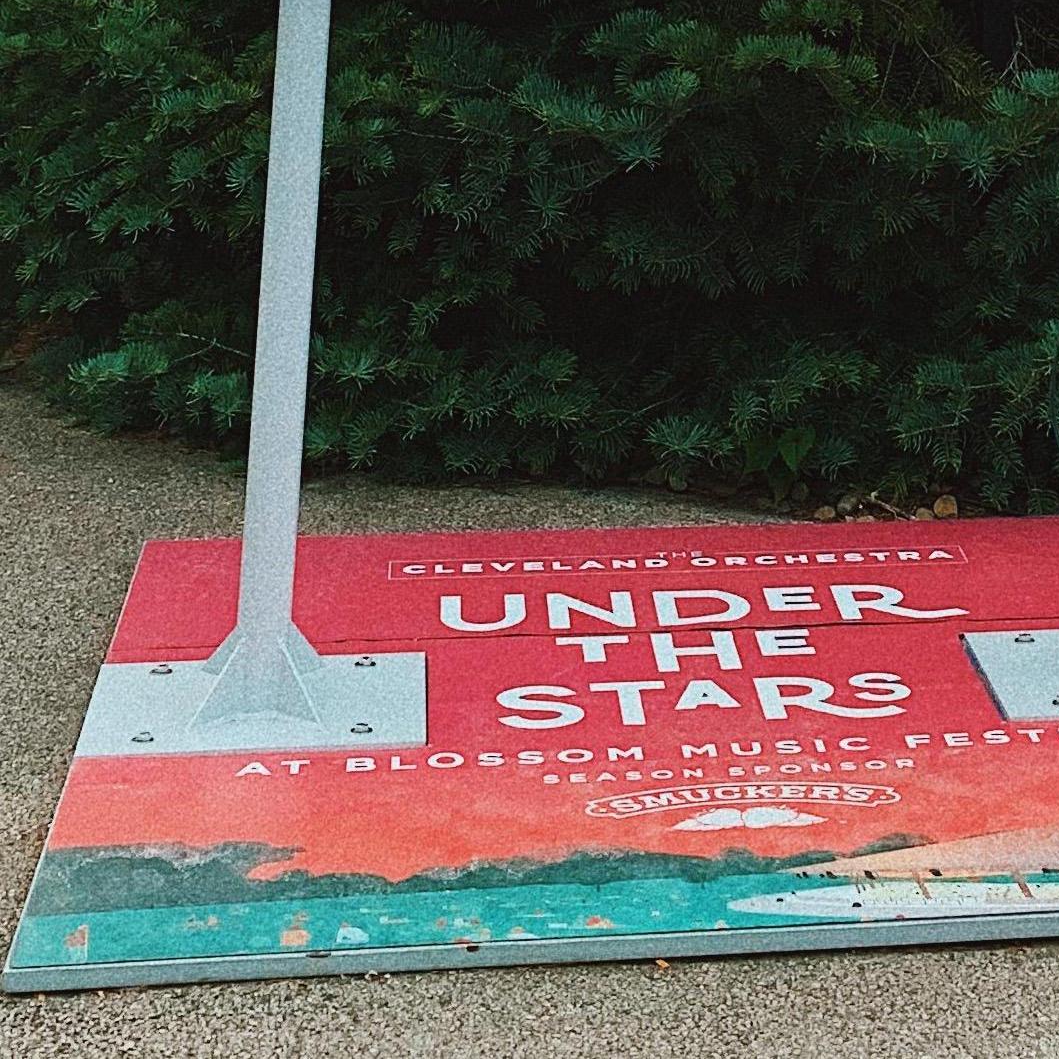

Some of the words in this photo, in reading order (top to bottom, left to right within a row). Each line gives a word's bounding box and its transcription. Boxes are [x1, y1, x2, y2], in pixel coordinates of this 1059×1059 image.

[402, 557, 670, 575] CLEVELAND
[691, 548, 954, 568] ORCHESTRA
[655, 550, 704, 559] THE
[439, 583, 970, 632] UNDER
[555, 628, 817, 673] THE
[496, 672, 911, 730] STARS
[235, 759, 311, 776] AT
[346, 745, 644, 773] BLOSSOM
[681, 736, 871, 759] MUSIC
[542, 767, 704, 785] SEASON
[728, 758, 915, 779] SPONSOR
[610, 784, 874, 812] SMUCKER'S
